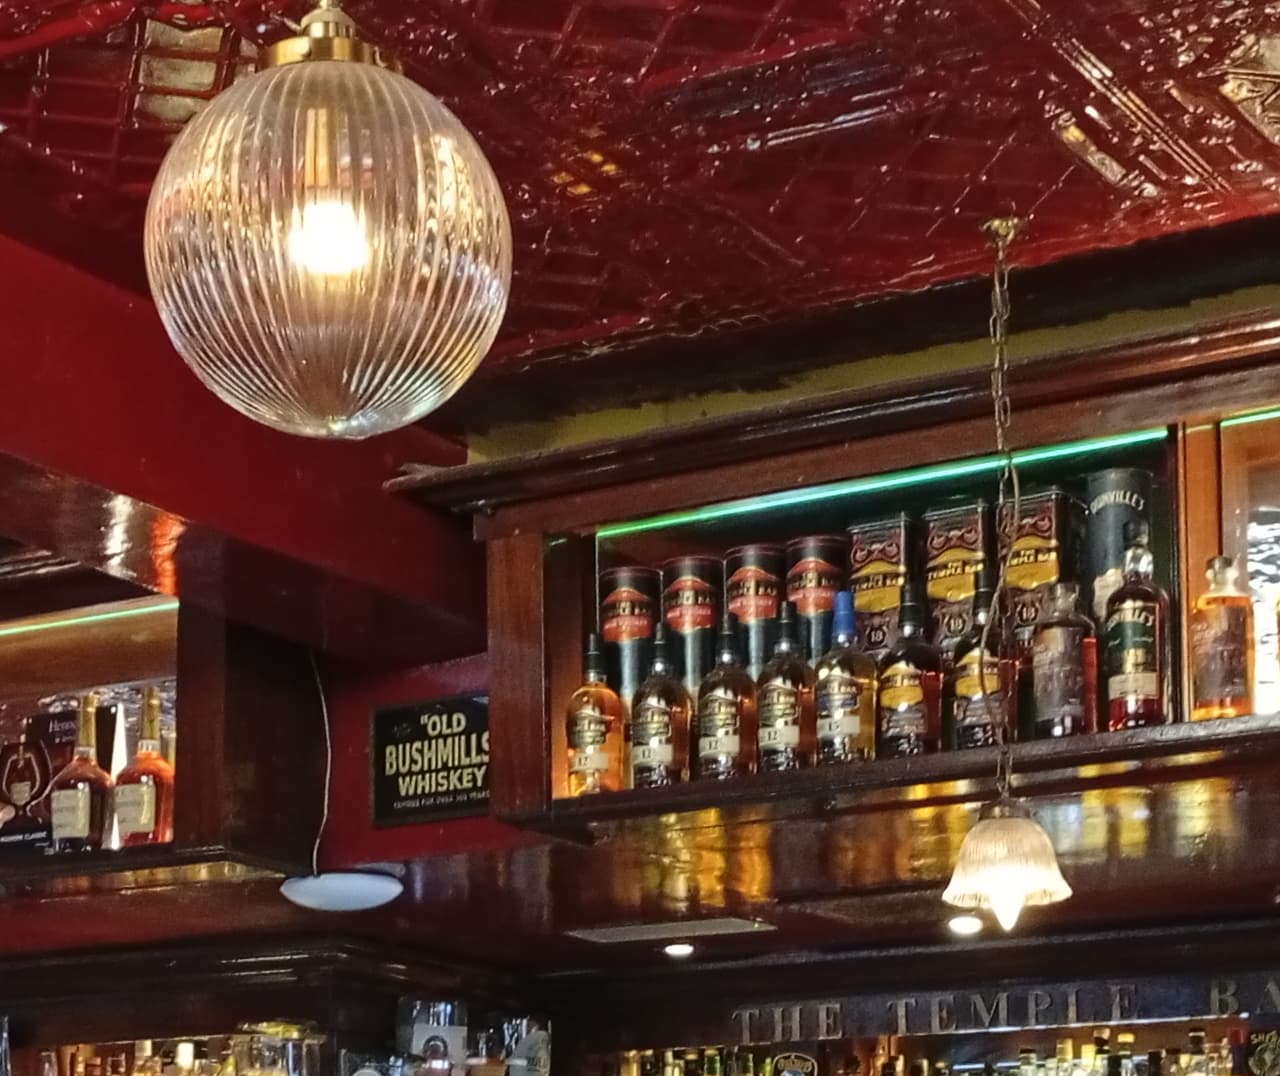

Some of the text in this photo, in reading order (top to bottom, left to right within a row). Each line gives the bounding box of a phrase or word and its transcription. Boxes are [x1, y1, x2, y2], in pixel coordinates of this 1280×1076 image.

[385, 730, 489, 776] BUSHMILLS
[398, 765, 487, 797] WHISKEY
[733, 1003, 844, 1045] THE
[890, 984, 1142, 1036] TEMPLE
